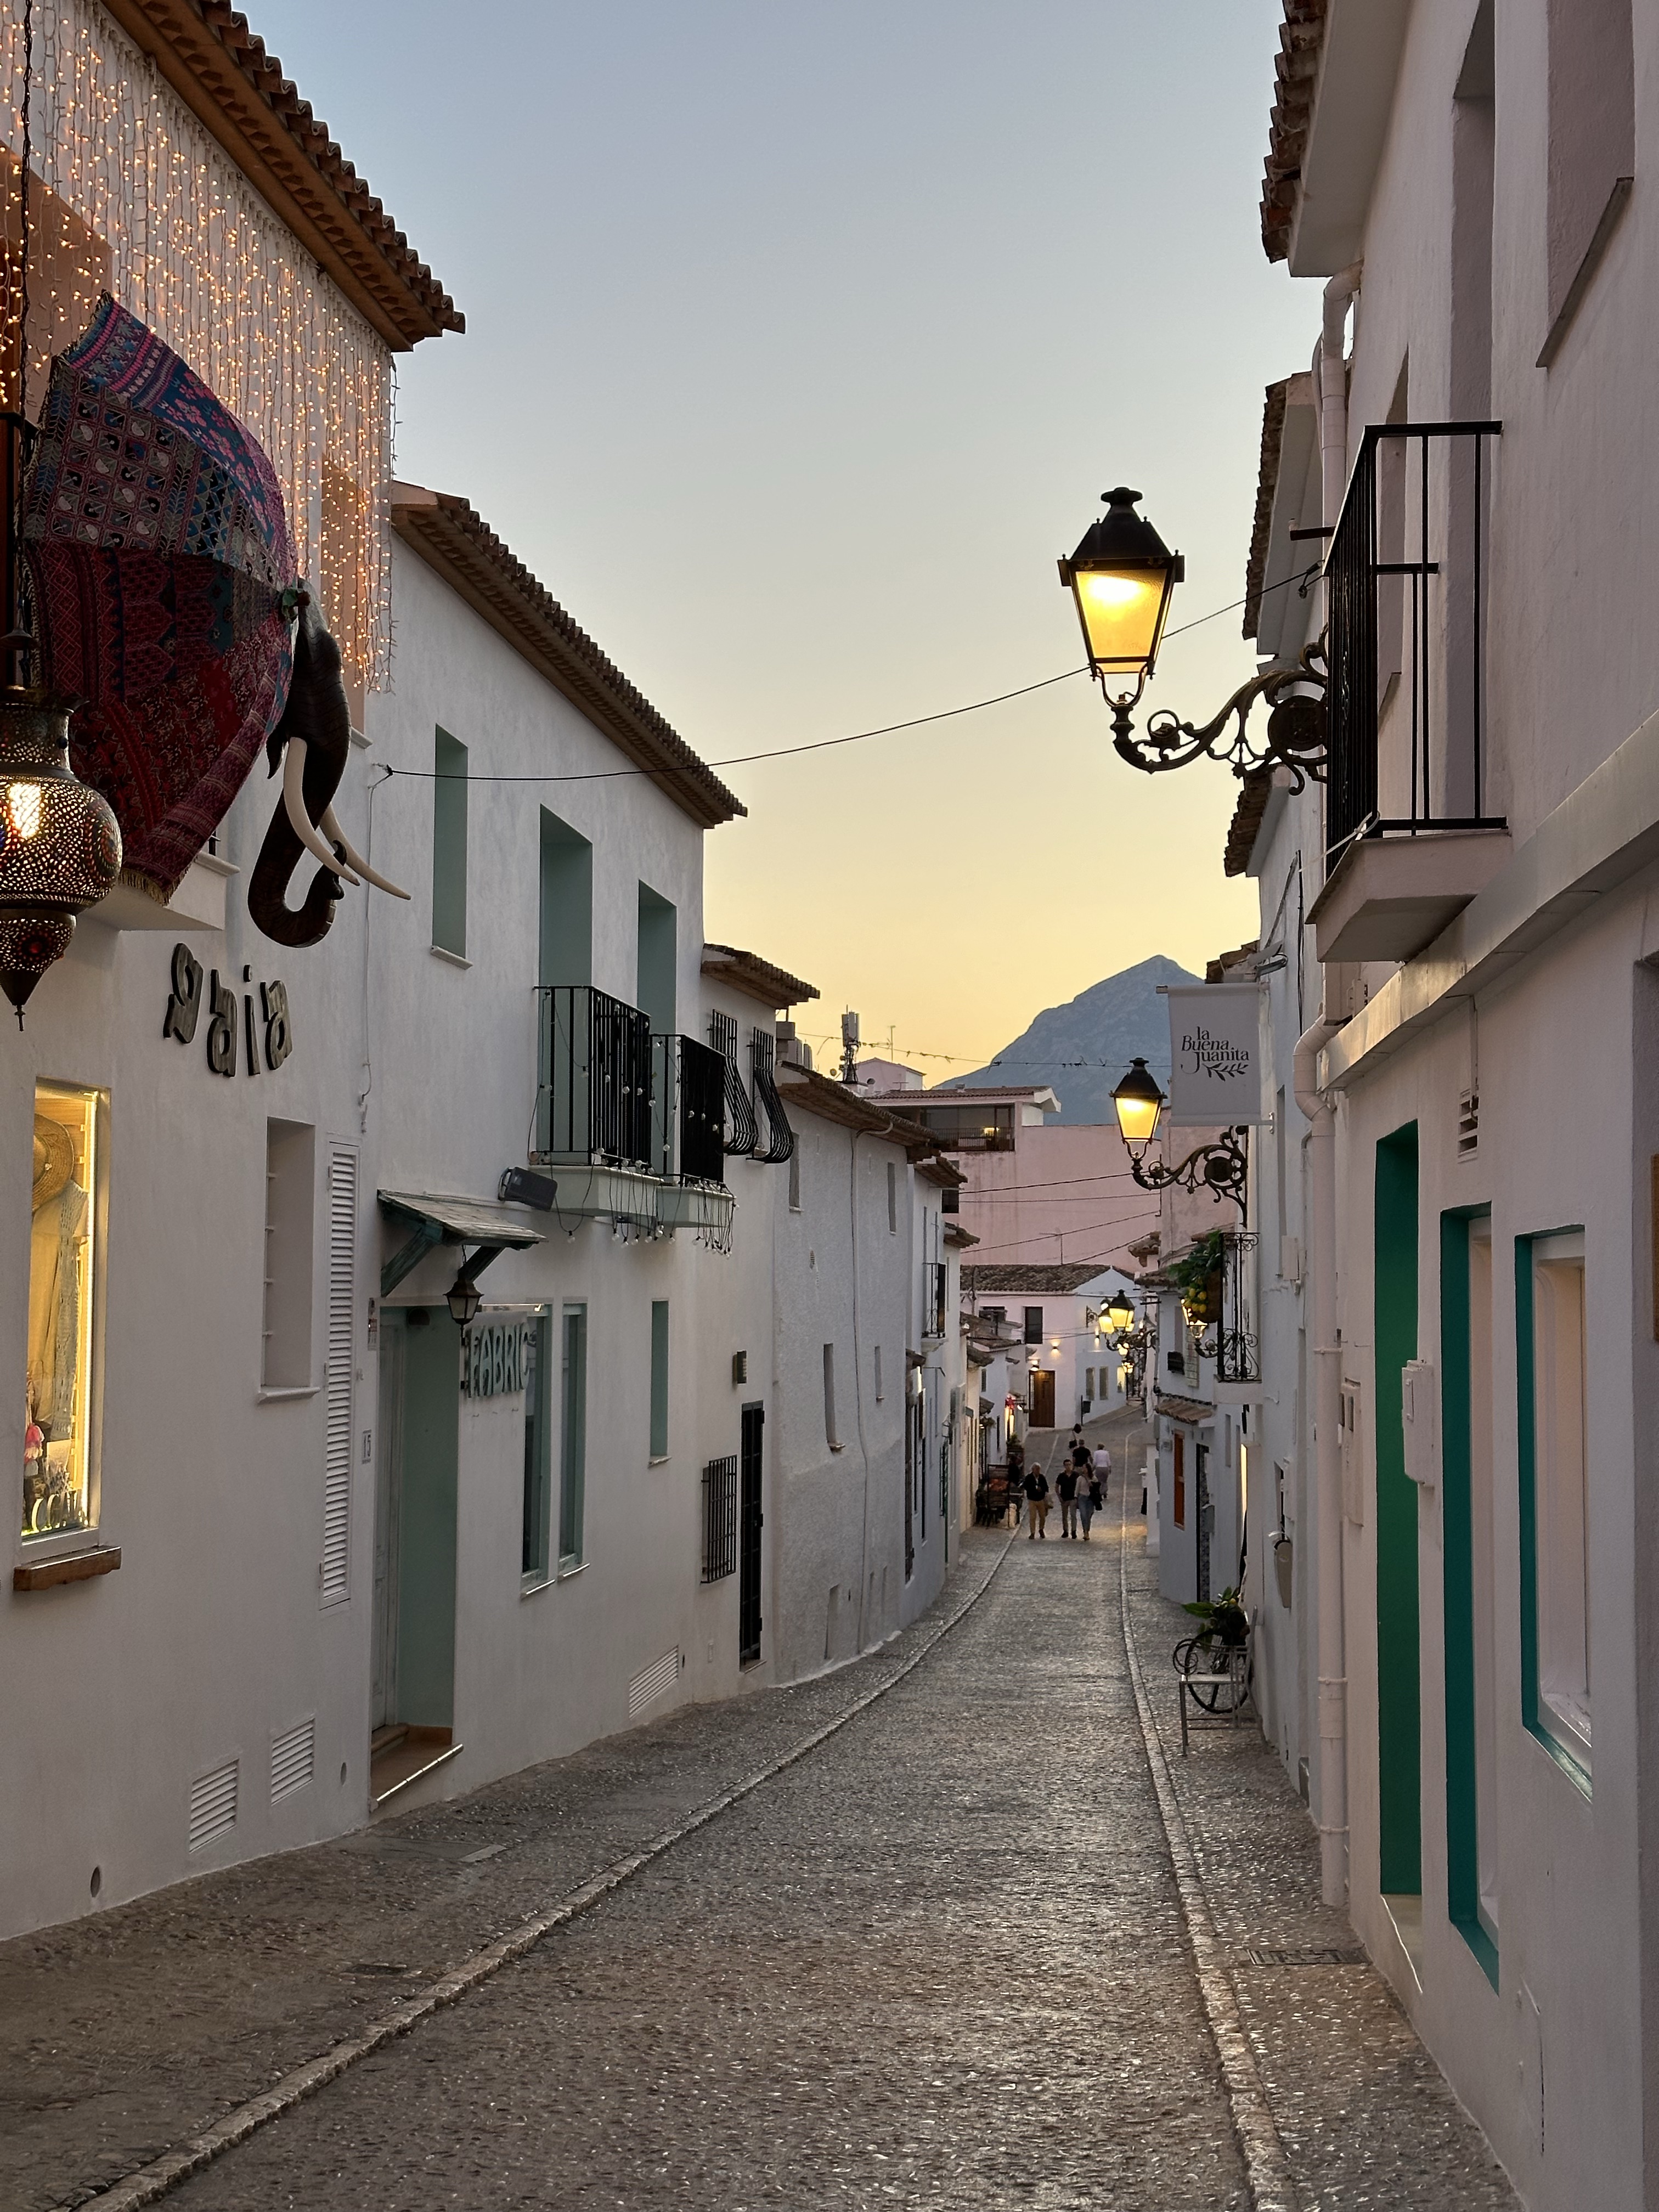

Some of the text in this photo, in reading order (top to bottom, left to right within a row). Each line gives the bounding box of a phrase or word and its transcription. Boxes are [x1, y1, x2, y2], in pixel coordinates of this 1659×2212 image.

[1181, 1035, 1229, 1051] Buena
[1197, 1026, 1210, 1040] la
[1180, 1047, 1249, 1074] Juanita
[469, 1322, 530, 1398] FABRIC
